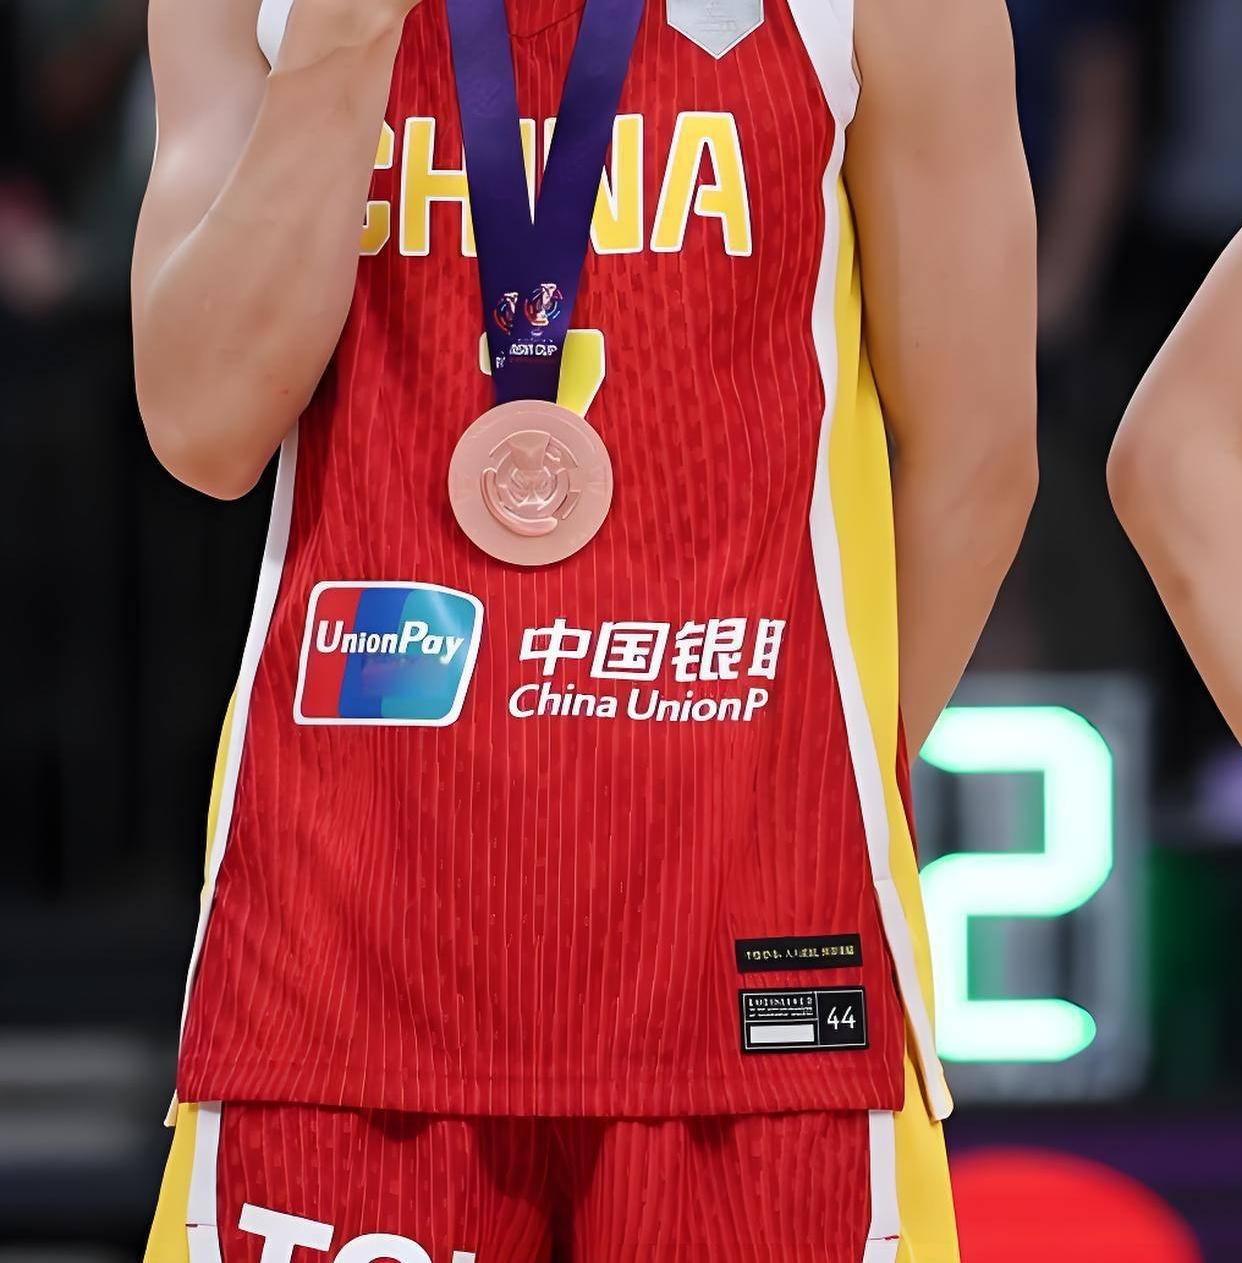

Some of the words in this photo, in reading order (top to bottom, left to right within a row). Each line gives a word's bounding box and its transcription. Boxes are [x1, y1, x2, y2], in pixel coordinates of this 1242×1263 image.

[316, 619, 465, 665] UnionPay
[508, 683, 617, 720] China
[626, 687, 768, 723] UnionP
[919, 705, 1113, 1063] 2
[827, 1006, 856, 1030] 44
